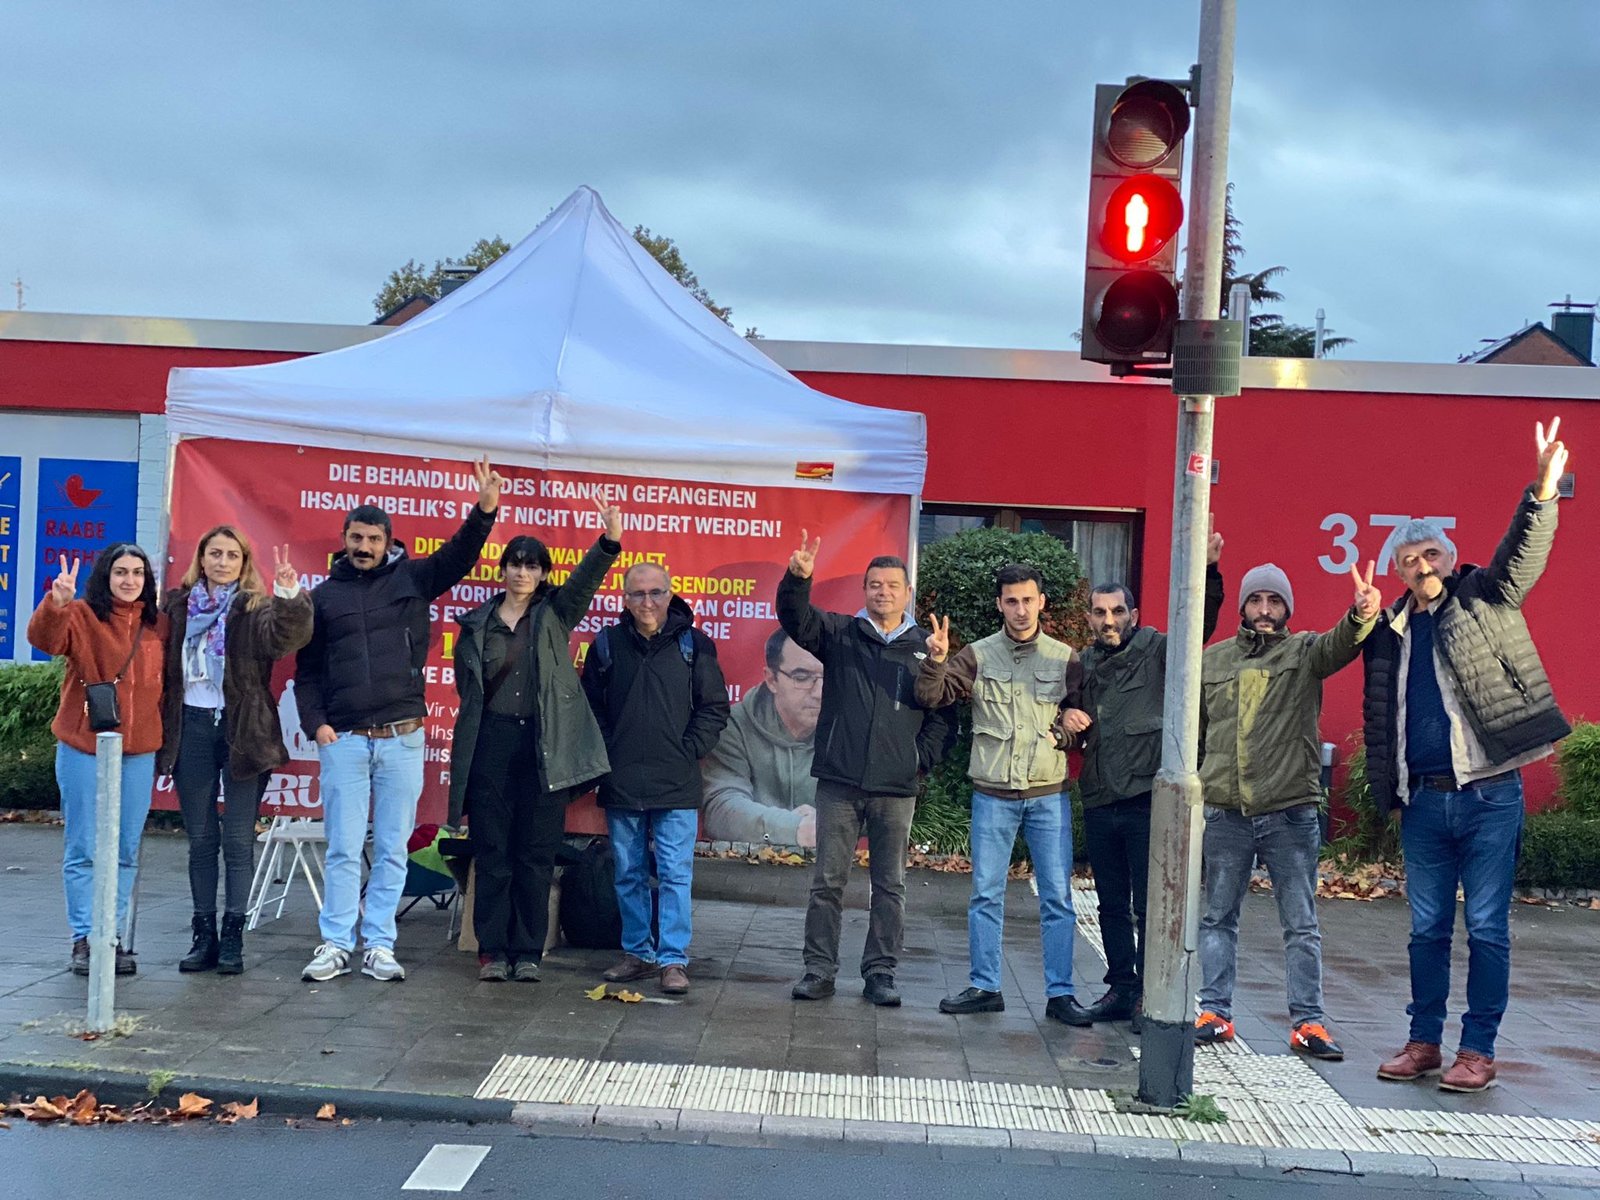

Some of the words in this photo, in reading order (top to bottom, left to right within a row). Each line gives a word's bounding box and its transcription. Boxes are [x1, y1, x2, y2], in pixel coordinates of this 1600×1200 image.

[329, 464, 361, 482] DIE
[366, 466, 480, 492] BEHANDLUN
[500, 478, 535, 496] DES
[541, 480, 627, 501] KRANKEN
[633, 485, 757, 508] GEFANGENEN
[46, 520, 105, 538] RAABE
[301, 491, 359, 511] IHSAN
[461, 502, 511, 523] DF
[515, 506, 570, 527] NICHT
[573, 510, 691, 534] VERINDERT
[695, 517, 781, 537] WERDEN!
[702, 622, 731, 639] SIE
